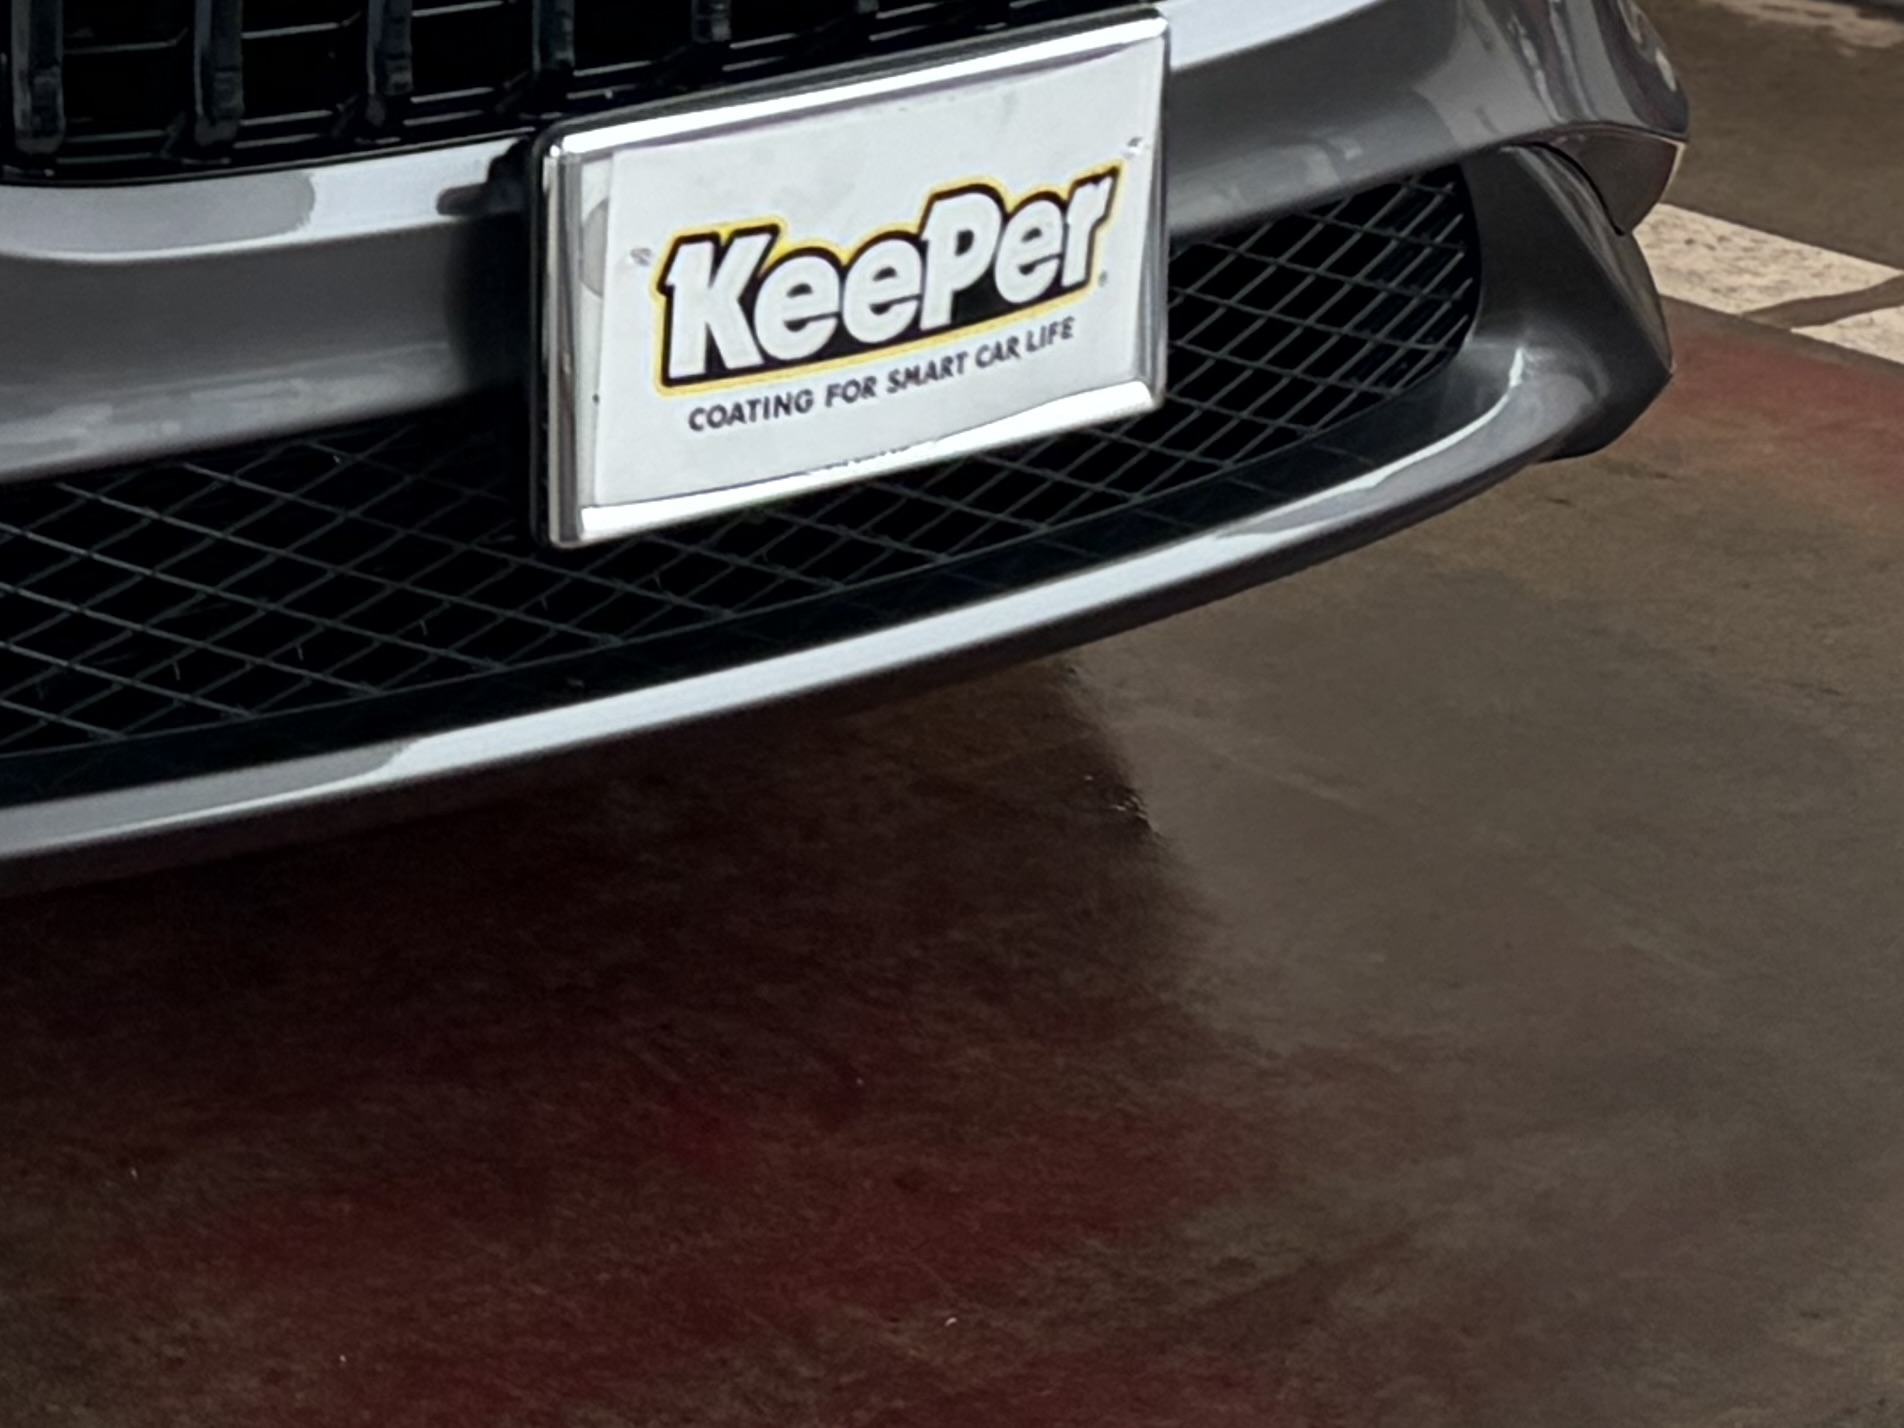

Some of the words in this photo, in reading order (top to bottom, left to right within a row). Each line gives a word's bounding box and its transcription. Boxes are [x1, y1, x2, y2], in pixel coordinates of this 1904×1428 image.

[654, 164, 1120, 388] KeePer
[688, 388, 815, 433] COATING
[824, 374, 878, 410] FOR
[886, 352, 967, 394] SMART
[974, 335, 1022, 370] CAR
[1026, 315, 1075, 353] LIFE
